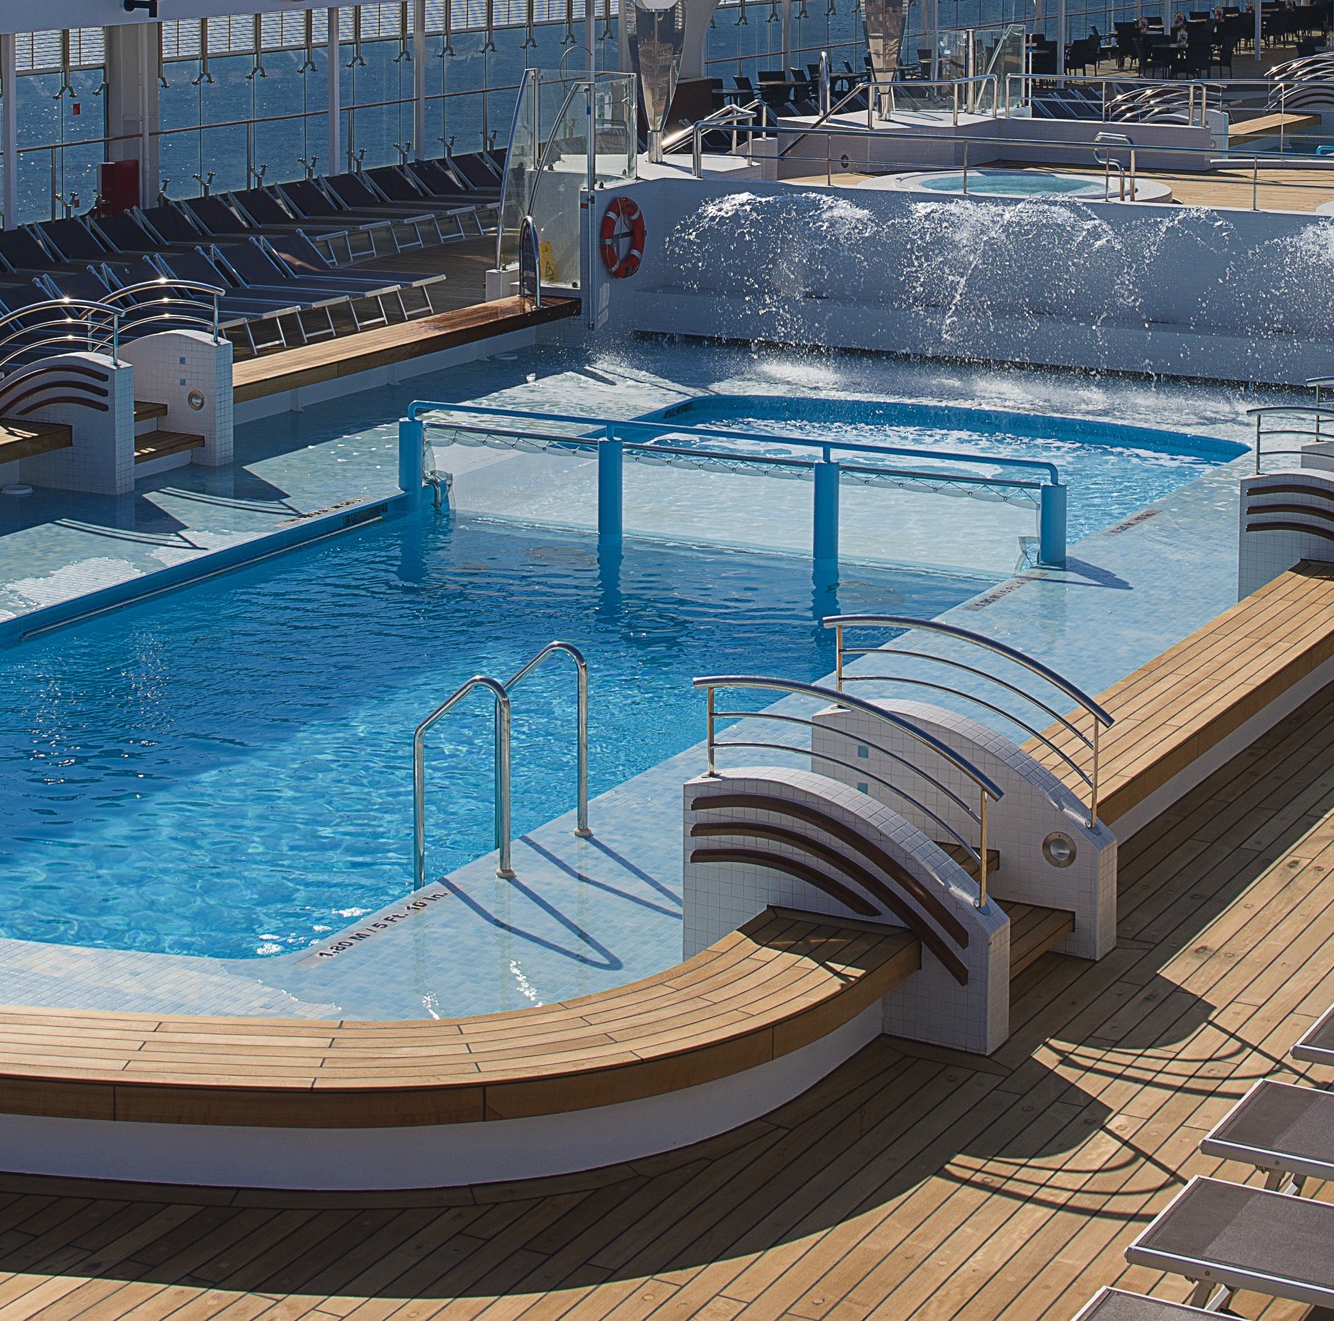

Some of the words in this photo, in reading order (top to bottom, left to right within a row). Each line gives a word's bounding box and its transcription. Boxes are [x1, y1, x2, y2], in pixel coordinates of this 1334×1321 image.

[319, 940, 354, 957] 1,80
[348, 932, 371, 941] M
[383, 913, 409, 923] Ft.
[406, 901, 428, 911] 10
[423, 892, 448, 901] In.
